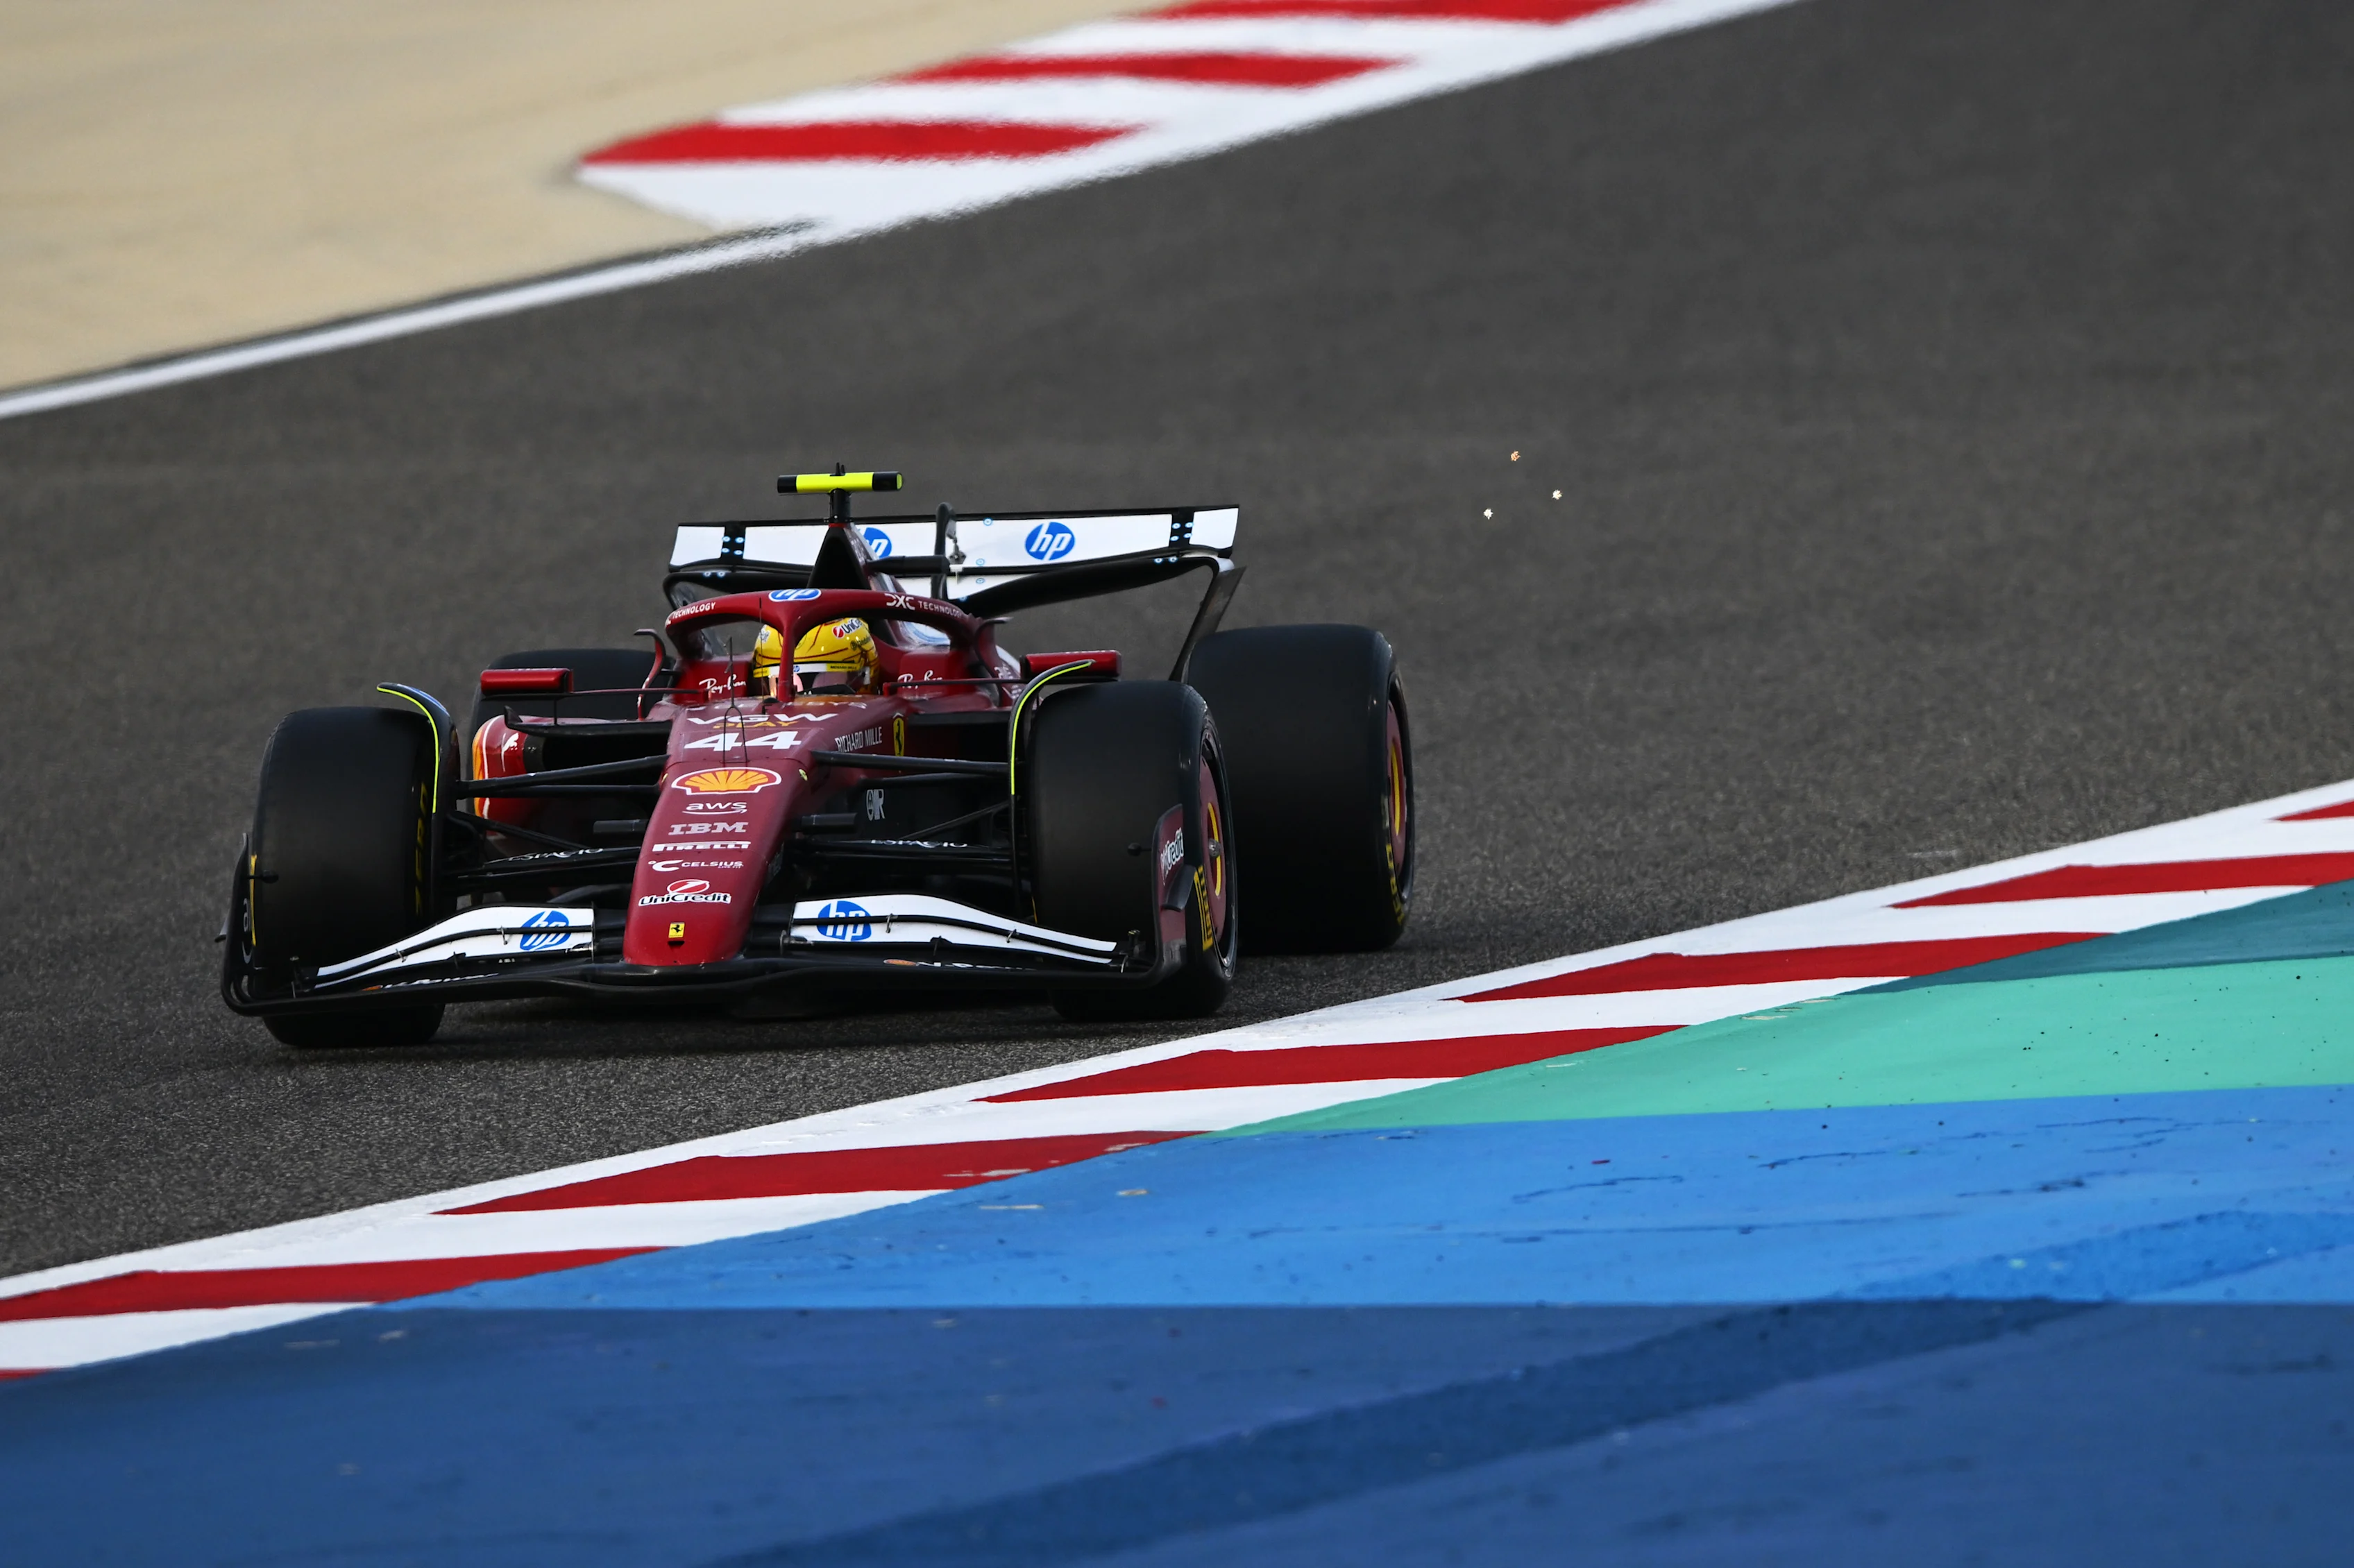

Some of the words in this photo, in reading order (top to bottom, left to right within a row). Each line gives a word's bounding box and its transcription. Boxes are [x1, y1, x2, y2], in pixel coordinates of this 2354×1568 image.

[1025, 522, 1075, 560] hp
[672, 602, 715, 619] TECHNOLOGY
[698, 674, 746, 694] Ray-Ban
[687, 713, 838, 725] VGW
[684, 731, 802, 751] 44
[835, 731, 863, 753] RICHARD
[864, 726, 883, 747] MILLE
[686, 802, 747, 810] aws
[668, 822, 748, 835] IBM
[652, 841, 751, 852] PIRELLI
[639, 892, 731, 905] UniCredit
[817, 901, 872, 941] hp
[520, 910, 572, 951] hp
